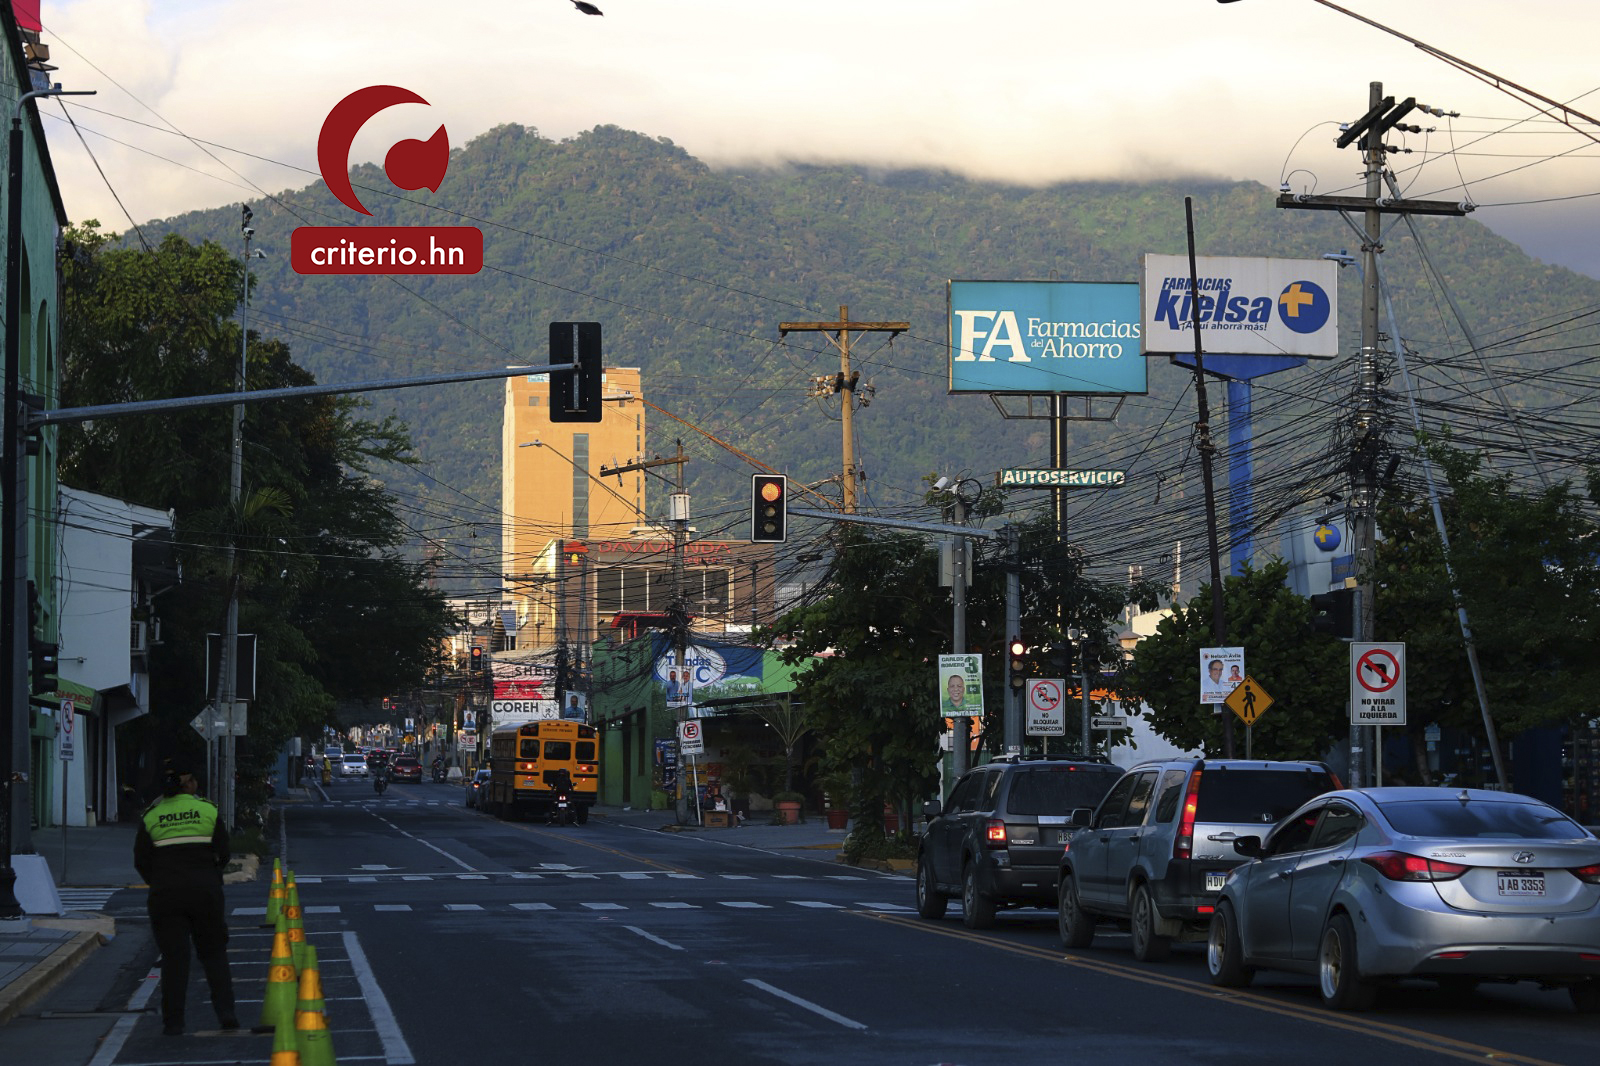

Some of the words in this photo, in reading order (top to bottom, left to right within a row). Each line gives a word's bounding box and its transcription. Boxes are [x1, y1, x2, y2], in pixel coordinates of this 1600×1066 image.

[1027, 317, 1140, 339] Farmacias
[1181, 321, 1210, 332] ¡Auí
[1211, 321, 1243, 331] ahorra
[1244, 321, 1268, 332] más!
[954, 310, 1032, 362] FA
[1031, 338, 1044, 348] del
[1041, 337, 1123, 359] Ahorro
[1002, 470, 1126, 485] AUTOSERVICIO
[964, 656, 979, 674] 3
[493, 701, 539, 713] COREH
[158, 809, 201, 824] POLICÍA
[1499, 878, 1505, 890] J
[1507, 878, 1519, 891] AB
[1521, 879, 1545, 891] 3353
